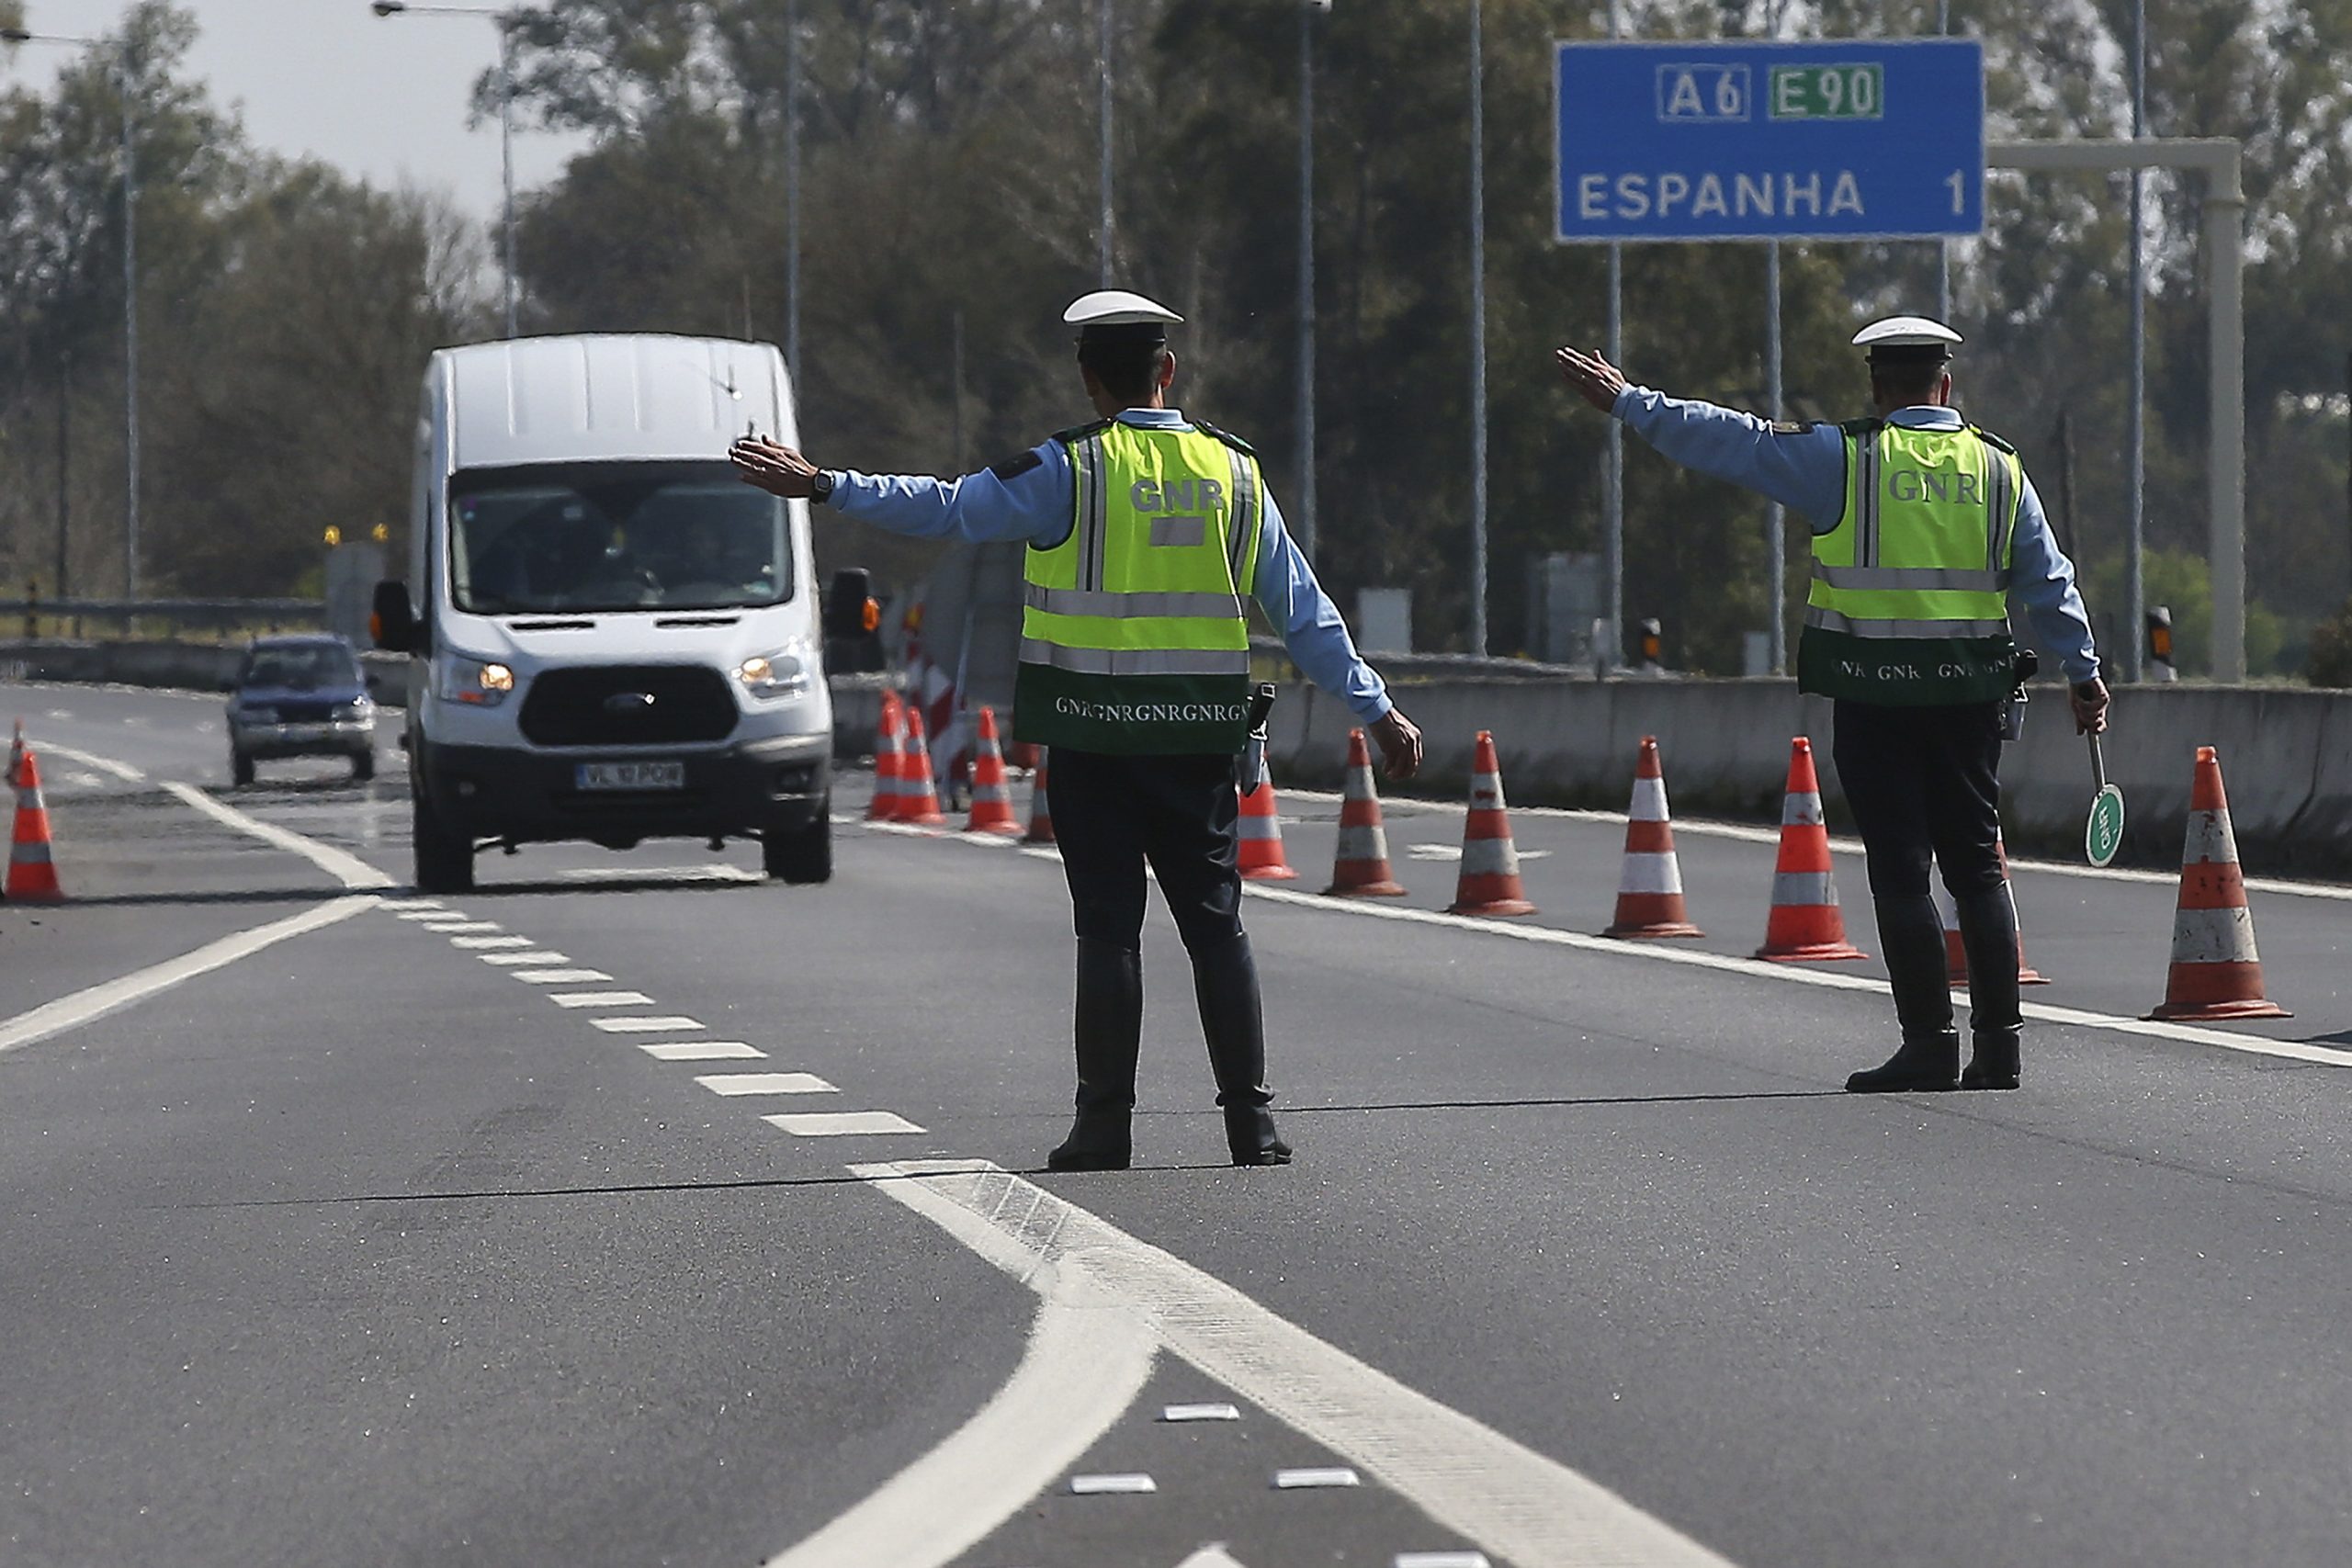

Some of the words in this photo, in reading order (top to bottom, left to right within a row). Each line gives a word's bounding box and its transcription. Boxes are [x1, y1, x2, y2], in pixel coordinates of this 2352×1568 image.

[1578, 170, 1865, 220] ESPANHA
[1943, 167, 1965, 216] 1
[1131, 479, 1225, 513] GNR
[1889, 469, 1984, 504] GNR
